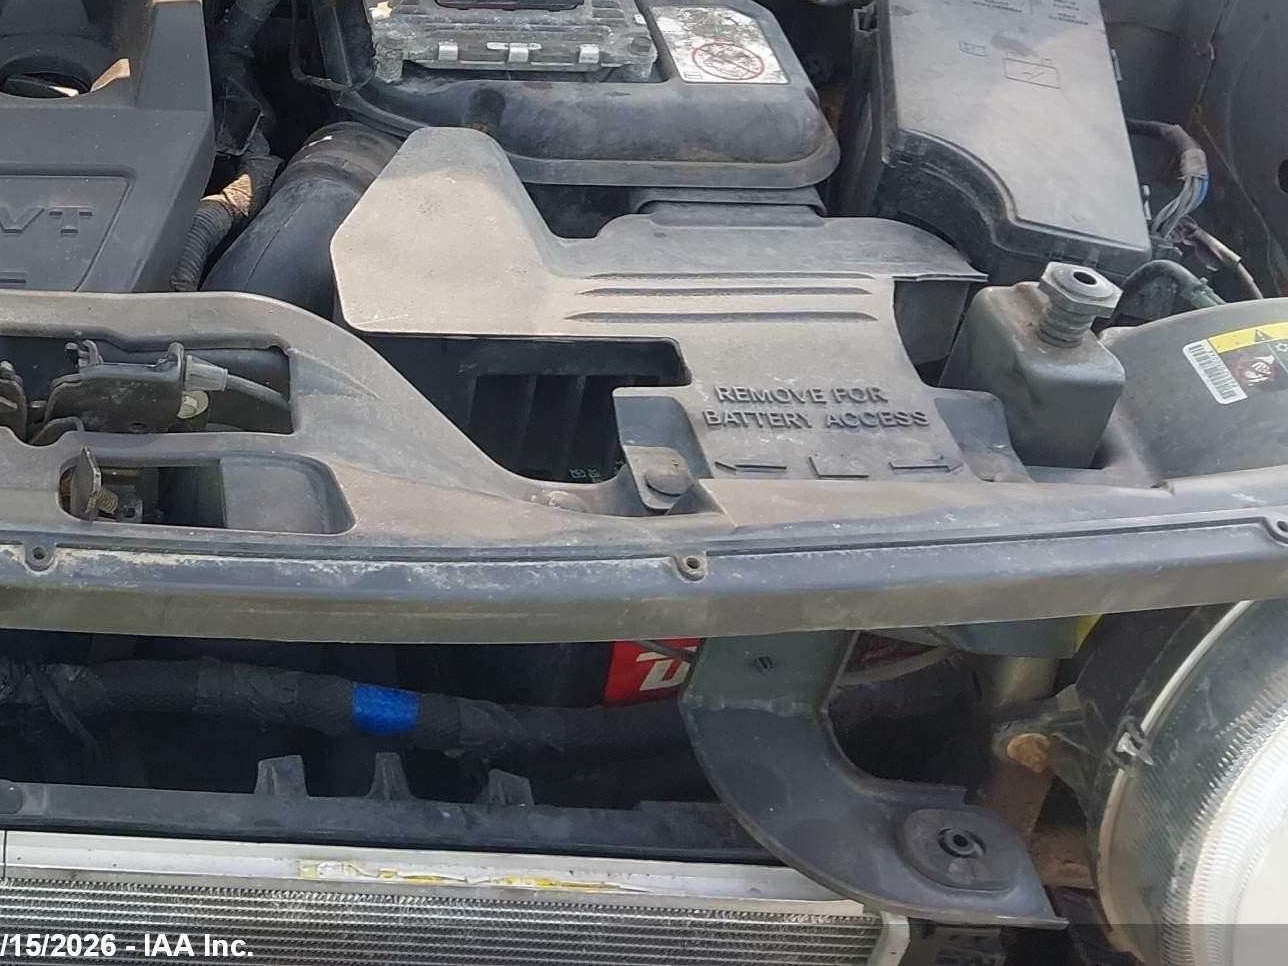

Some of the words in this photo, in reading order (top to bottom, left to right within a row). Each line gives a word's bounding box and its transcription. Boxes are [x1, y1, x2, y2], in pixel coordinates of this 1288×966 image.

[714, 385, 827, 404] REMOVE
[830, 387, 889, 404] FOR
[702, 409, 813, 429] BATTERY
[825, 410, 930, 429] ACCESS
